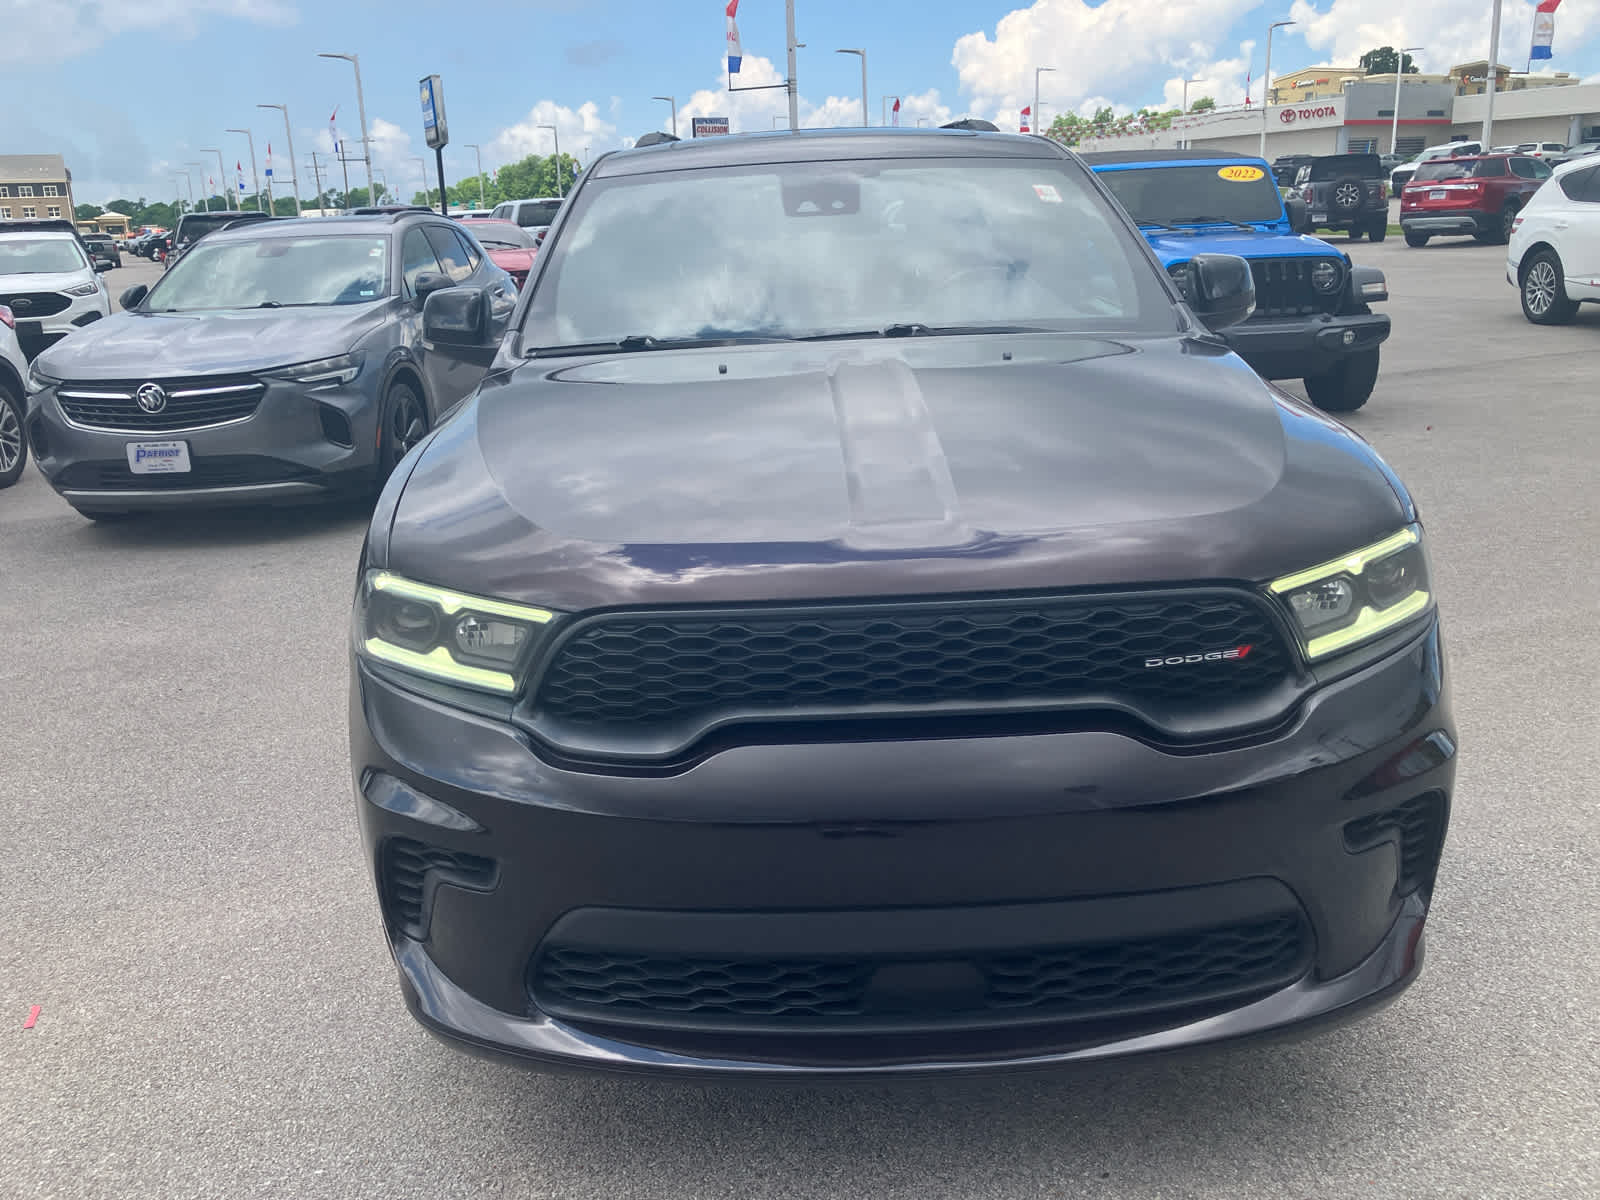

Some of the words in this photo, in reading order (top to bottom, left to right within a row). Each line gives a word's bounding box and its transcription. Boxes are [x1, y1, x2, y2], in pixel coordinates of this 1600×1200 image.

[1297, 105, 1336, 119] TOYOTA
[696, 125, 728, 133] COLLISION
[1225, 168, 1256, 178] 2022
[1144, 649, 1241, 667] DODGE
